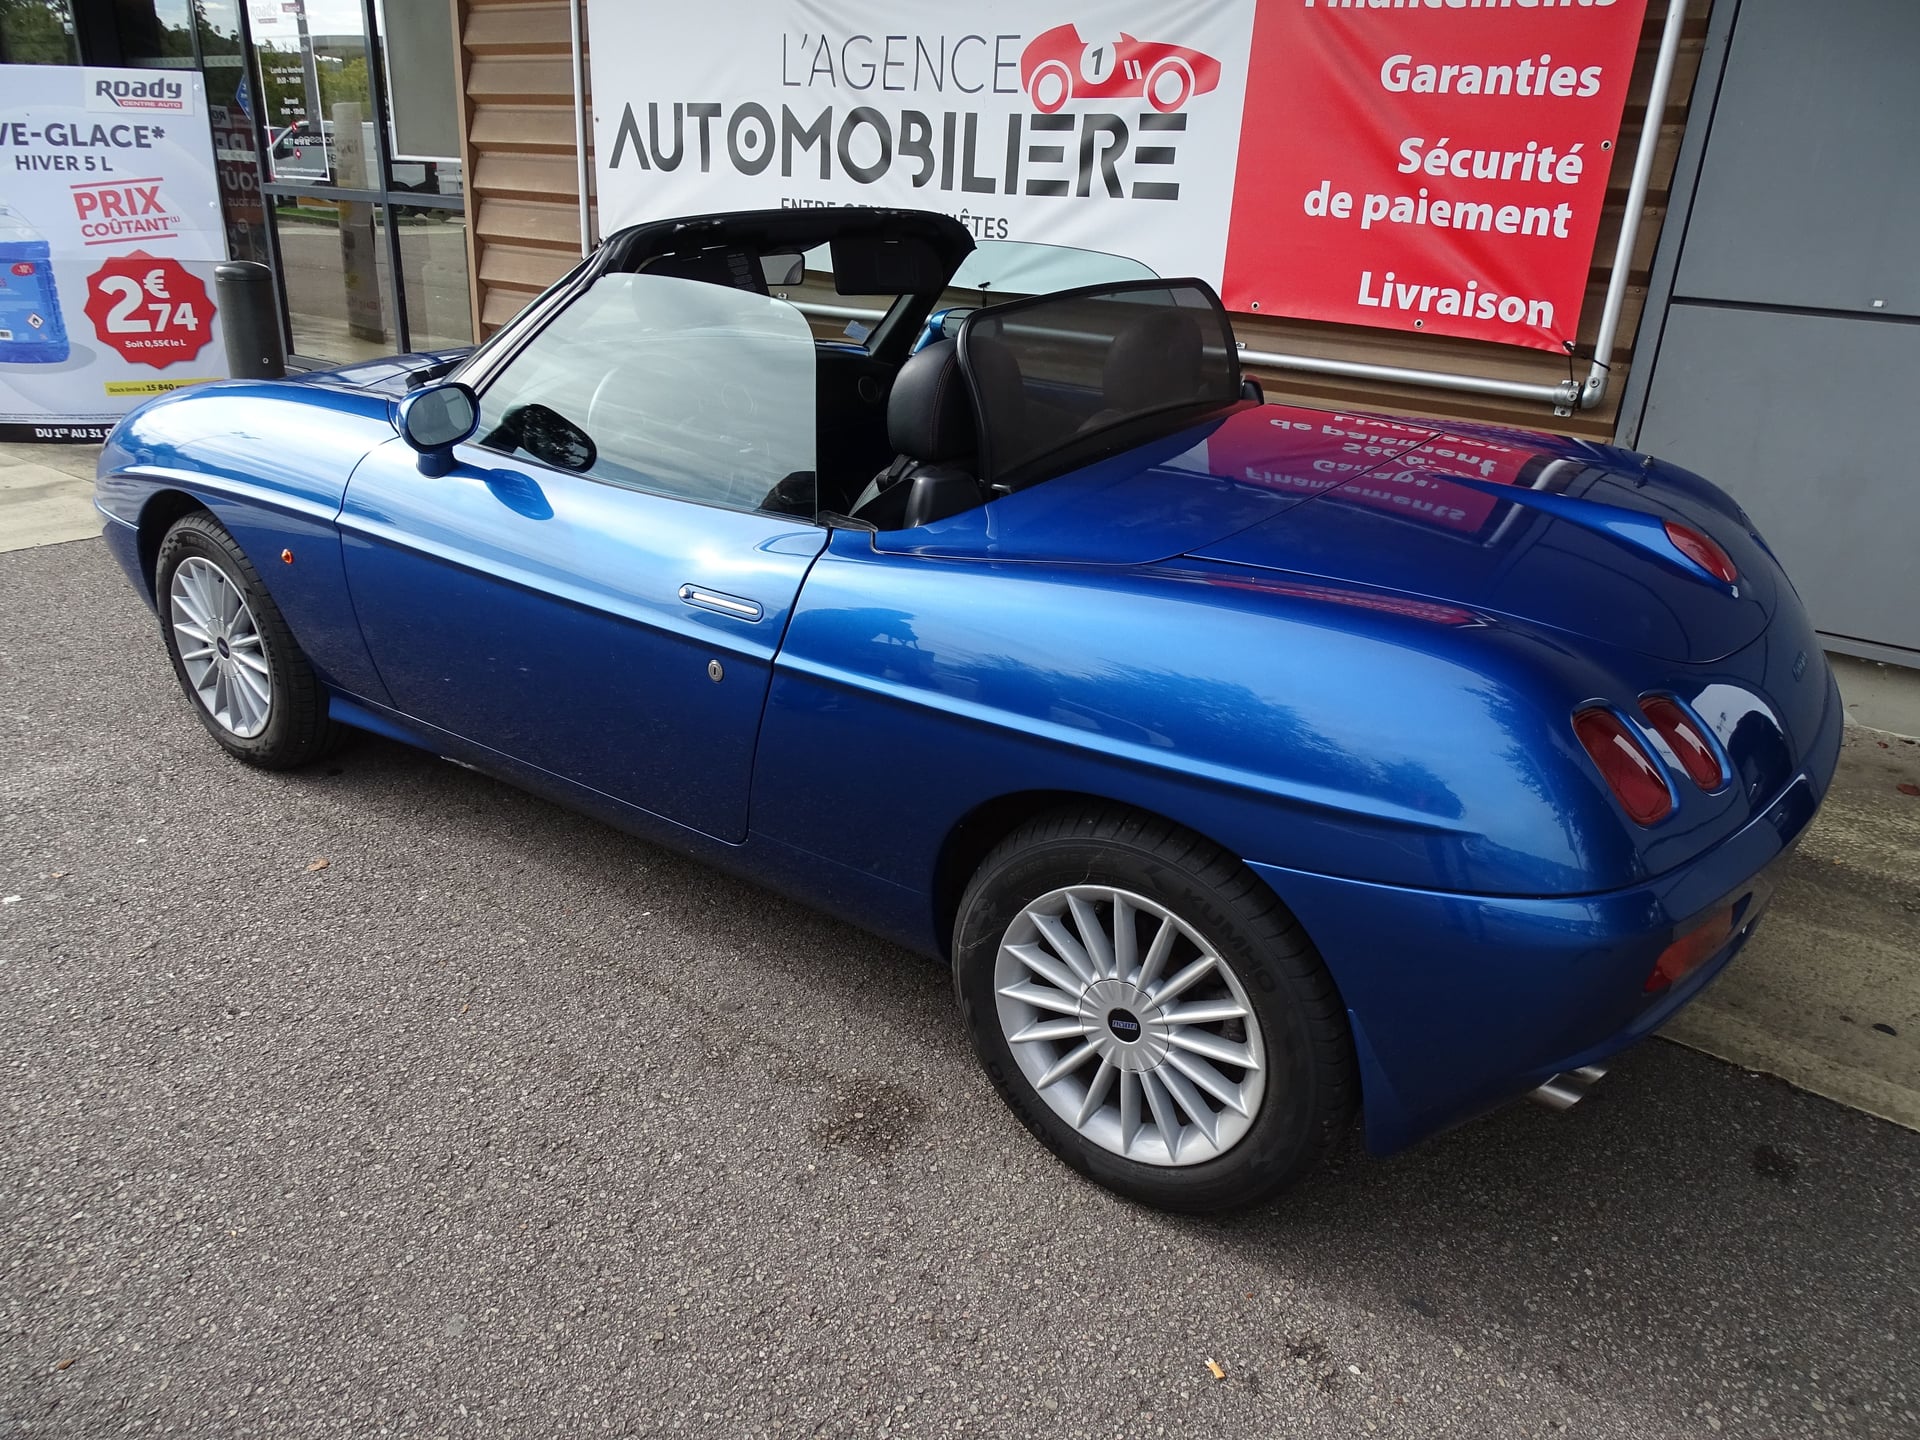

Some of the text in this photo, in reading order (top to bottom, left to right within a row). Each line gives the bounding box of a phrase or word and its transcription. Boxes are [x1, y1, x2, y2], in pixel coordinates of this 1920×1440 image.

[782, 33, 1021, 94] L'AGENCE
[1091, 47, 1104, 76] 1
[1380, 54, 1602, 97] Garanties
[96, 77, 182, 107] Roady
[121, 100, 182, 109] CENTRE AUTO
[15, 155, 113, 171] HIVER 5 L
[609, 101, 1187, 200] AUTOMOBILIERE
[1397, 137, 1584, 183] Sécurité
[73, 186, 166, 220] PRIX
[1304, 180, 1573, 238] de paiement
[1357, 271, 1554, 328] Livraison
[125, 340, 143, 349] Soit
[170, 339, 180, 348] le
[146, 384, 157, 392] 15
[35, 428, 52, 438] DU
[71, 428, 87, 438] AU
[89, 428, 101, 438] 31
